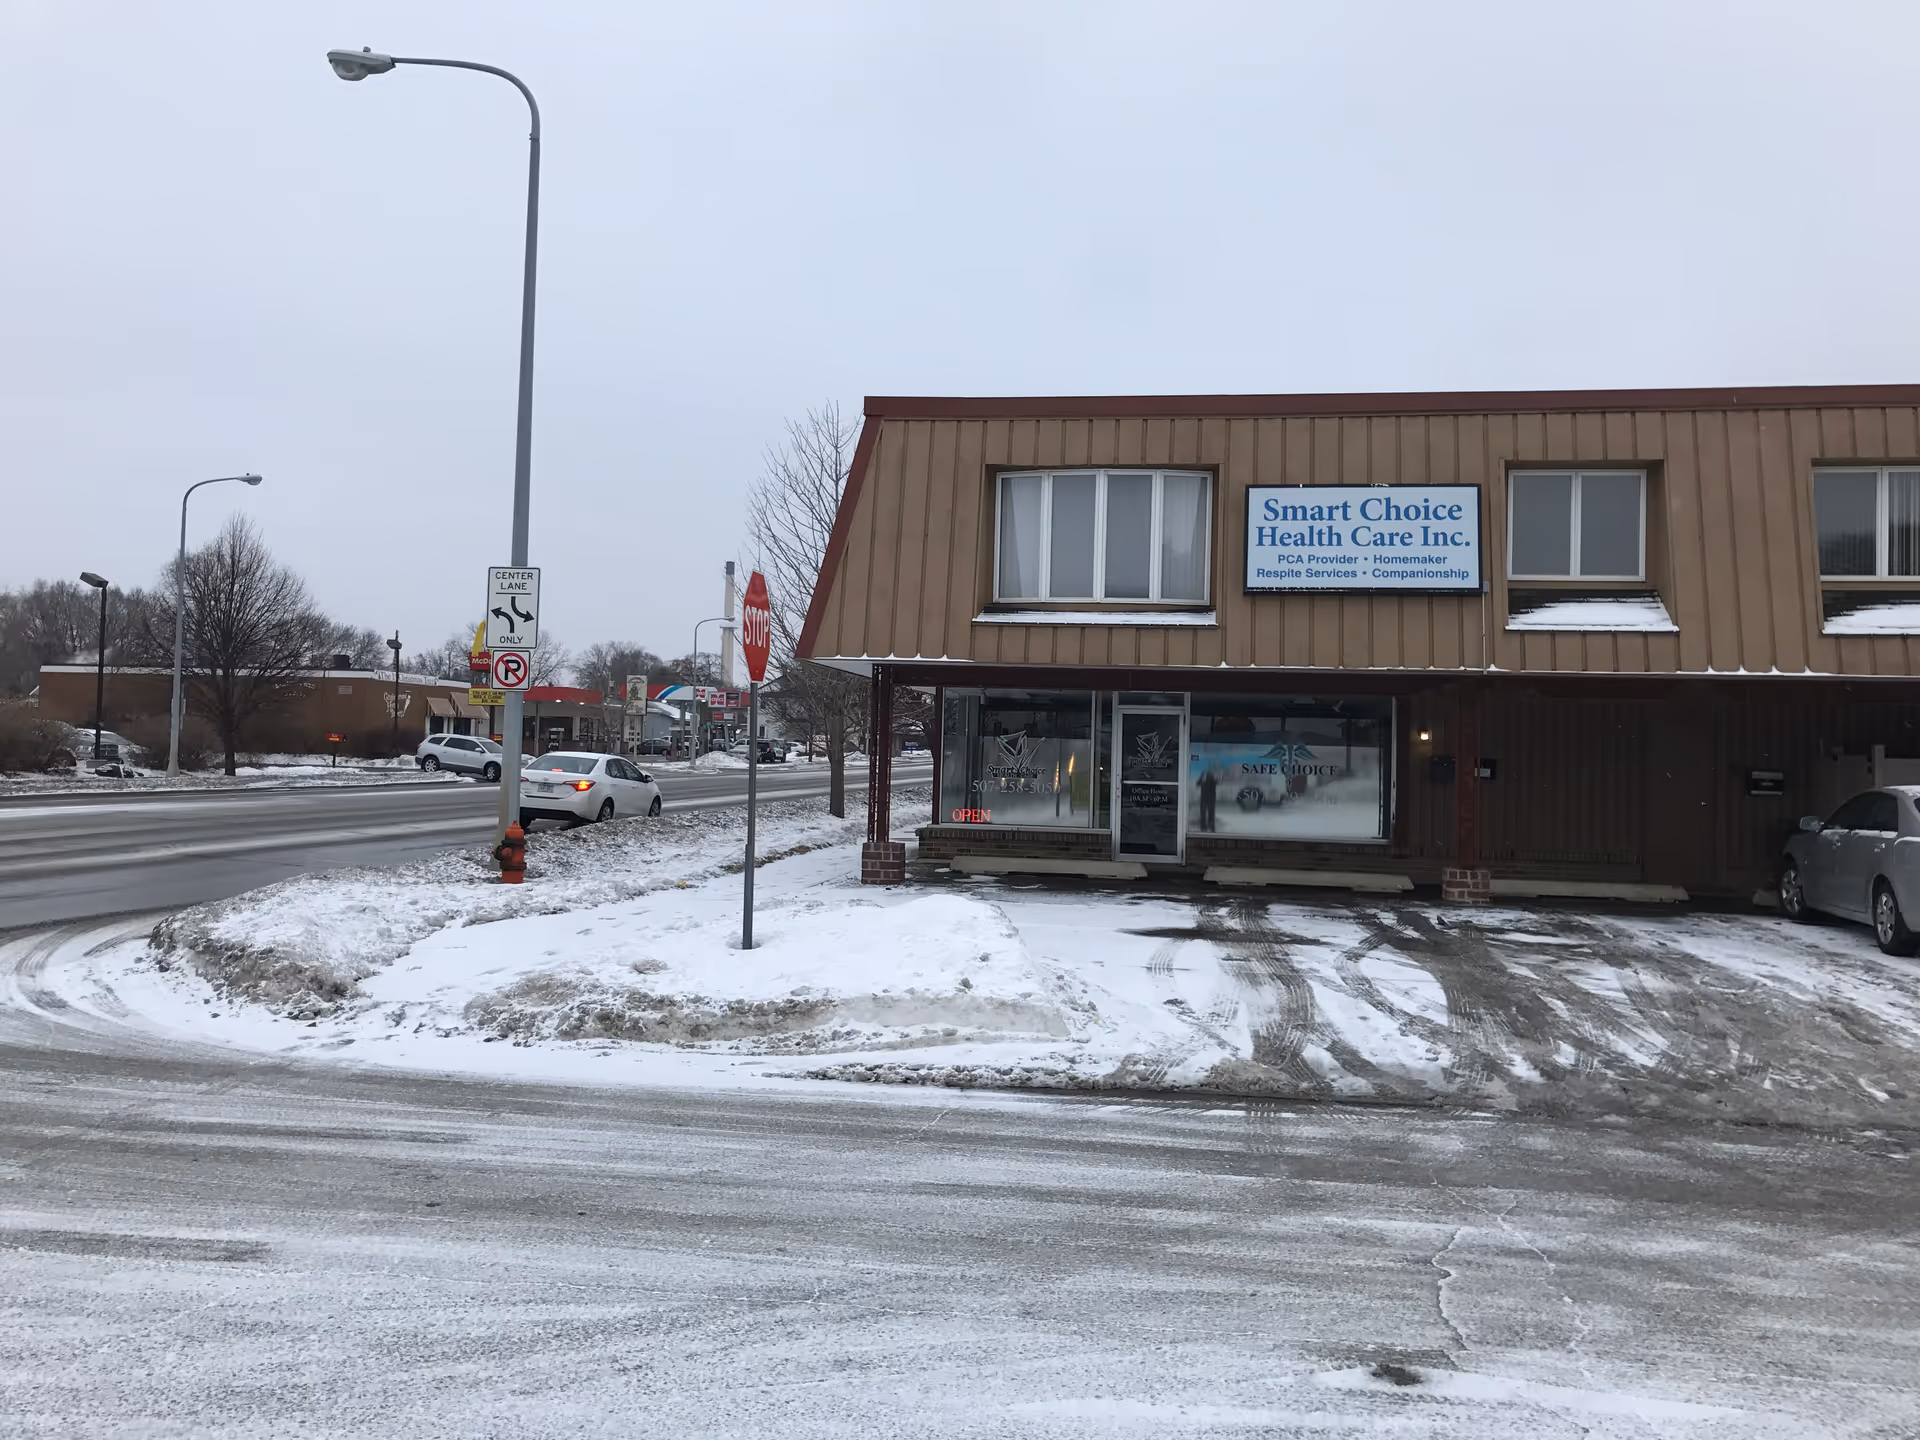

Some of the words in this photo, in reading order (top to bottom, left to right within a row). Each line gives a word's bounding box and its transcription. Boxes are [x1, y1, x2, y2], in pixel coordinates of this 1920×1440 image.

[1263, 498, 1352, 521] Smart
[1359, 497, 1463, 521] Choice
[1255, 525, 1343, 547] Health
[1350, 525, 1413, 547] Care
[1420, 525, 1471, 547] Inc.
[1277, 554, 1304, 564] PCA
[1307, 554, 1359, 564] Provider
[1373, 554, 1448, 564] Homemaker
[495, 571, 533, 580] CENTER
[1256, 568, 1302, 580] Respite
[1305, 568, 1358, 578] Services
[1372, 568, 1470, 580] Companionship
[500, 582, 527, 590] LANE
[744, 604, 770, 648] STOP
[499, 635, 524, 644] ONLY
[987, 764, 1015, 774] Smart
[1020, 765, 1047, 774] Choice
[1241, 763, 1278, 775] SAFE
[1281, 764, 1338, 776] CHOICE
[951, 808, 992, 823] OPEN
